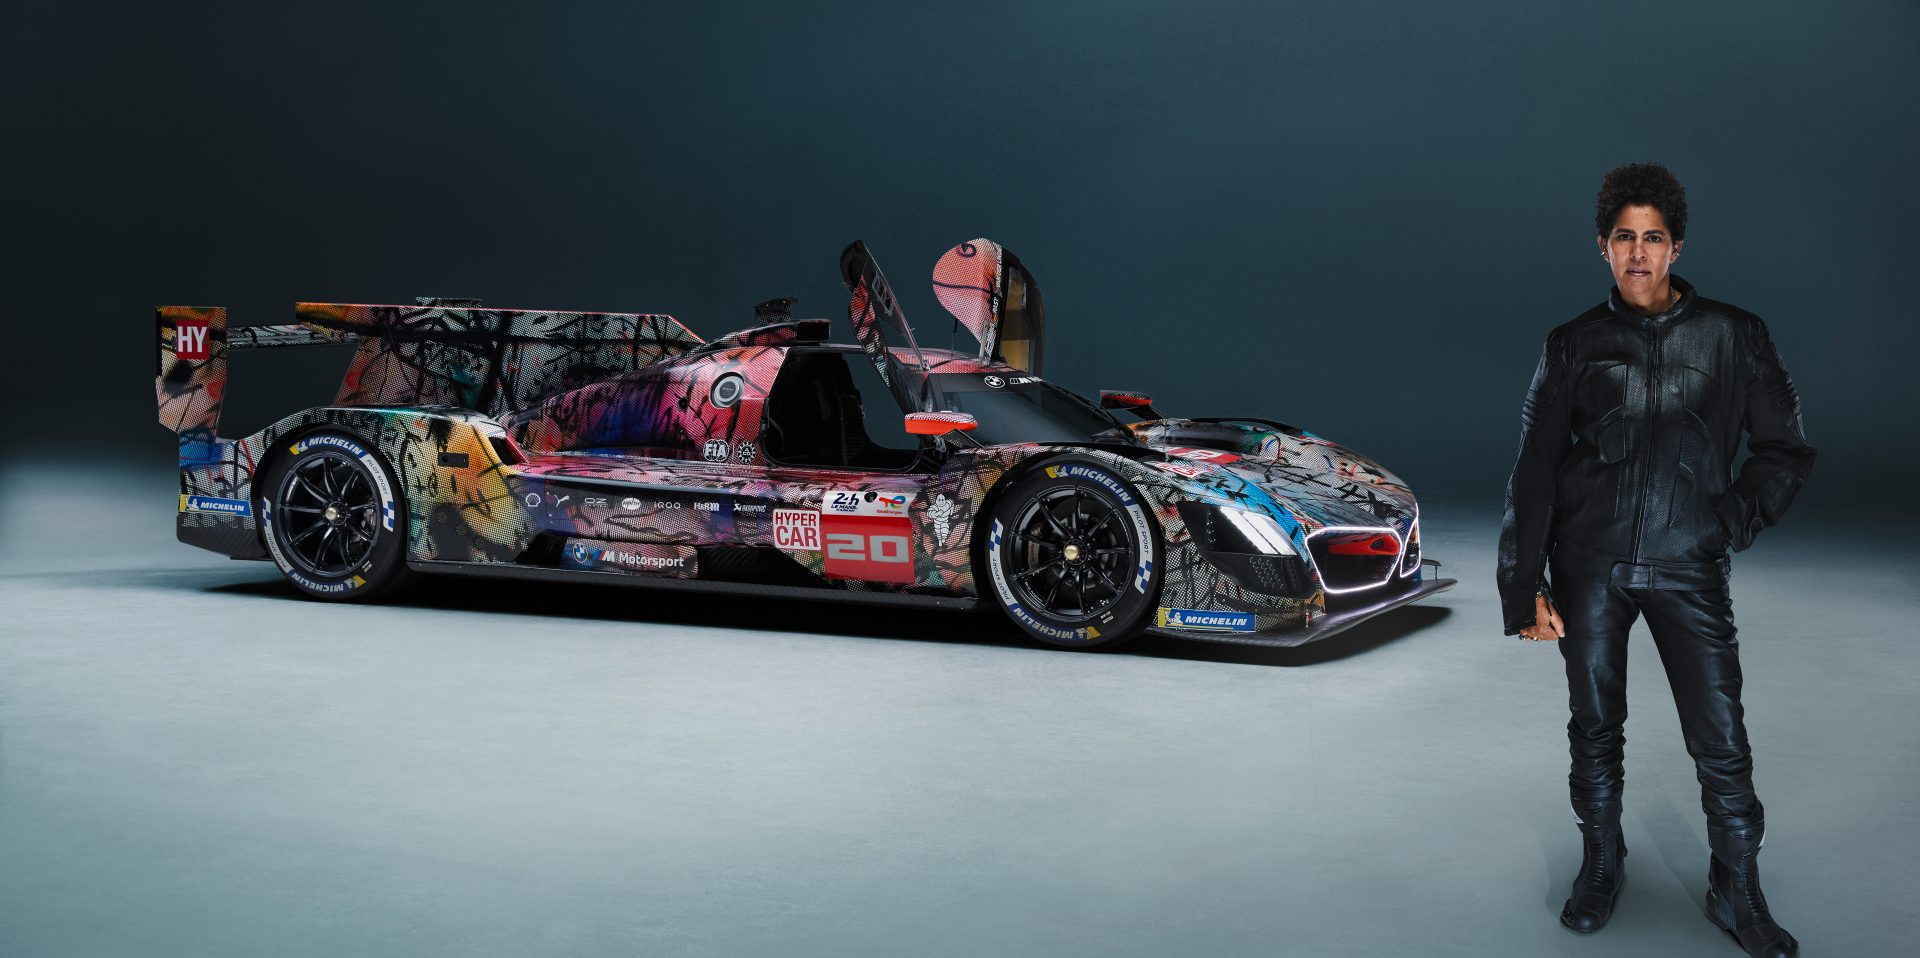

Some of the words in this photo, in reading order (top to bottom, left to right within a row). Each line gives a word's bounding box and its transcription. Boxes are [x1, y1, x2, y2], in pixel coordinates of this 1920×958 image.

[177, 325, 207, 352] HY
[308, 437, 363, 455] MICHELIN
[367, 459, 378, 477] PILOT
[379, 476, 388, 495] SPORT
[200, 500, 245, 512] MICHELIN
[1070, 466, 1132, 502] MICHELIN
[1133, 510, 1144, 528] PILOT
[1141, 530, 1149, 554] SPORT
[775, 512, 817, 527] HYPER
[776, 525, 818, 548] CAR
[826, 533, 910, 563] 20
[619, 552, 685, 569] Motorsport
[292, 572, 344, 592] MICHELIN
[1013, 607, 1075, 639] MICHELIN
[1185, 615, 1248, 626] MICHELIN
